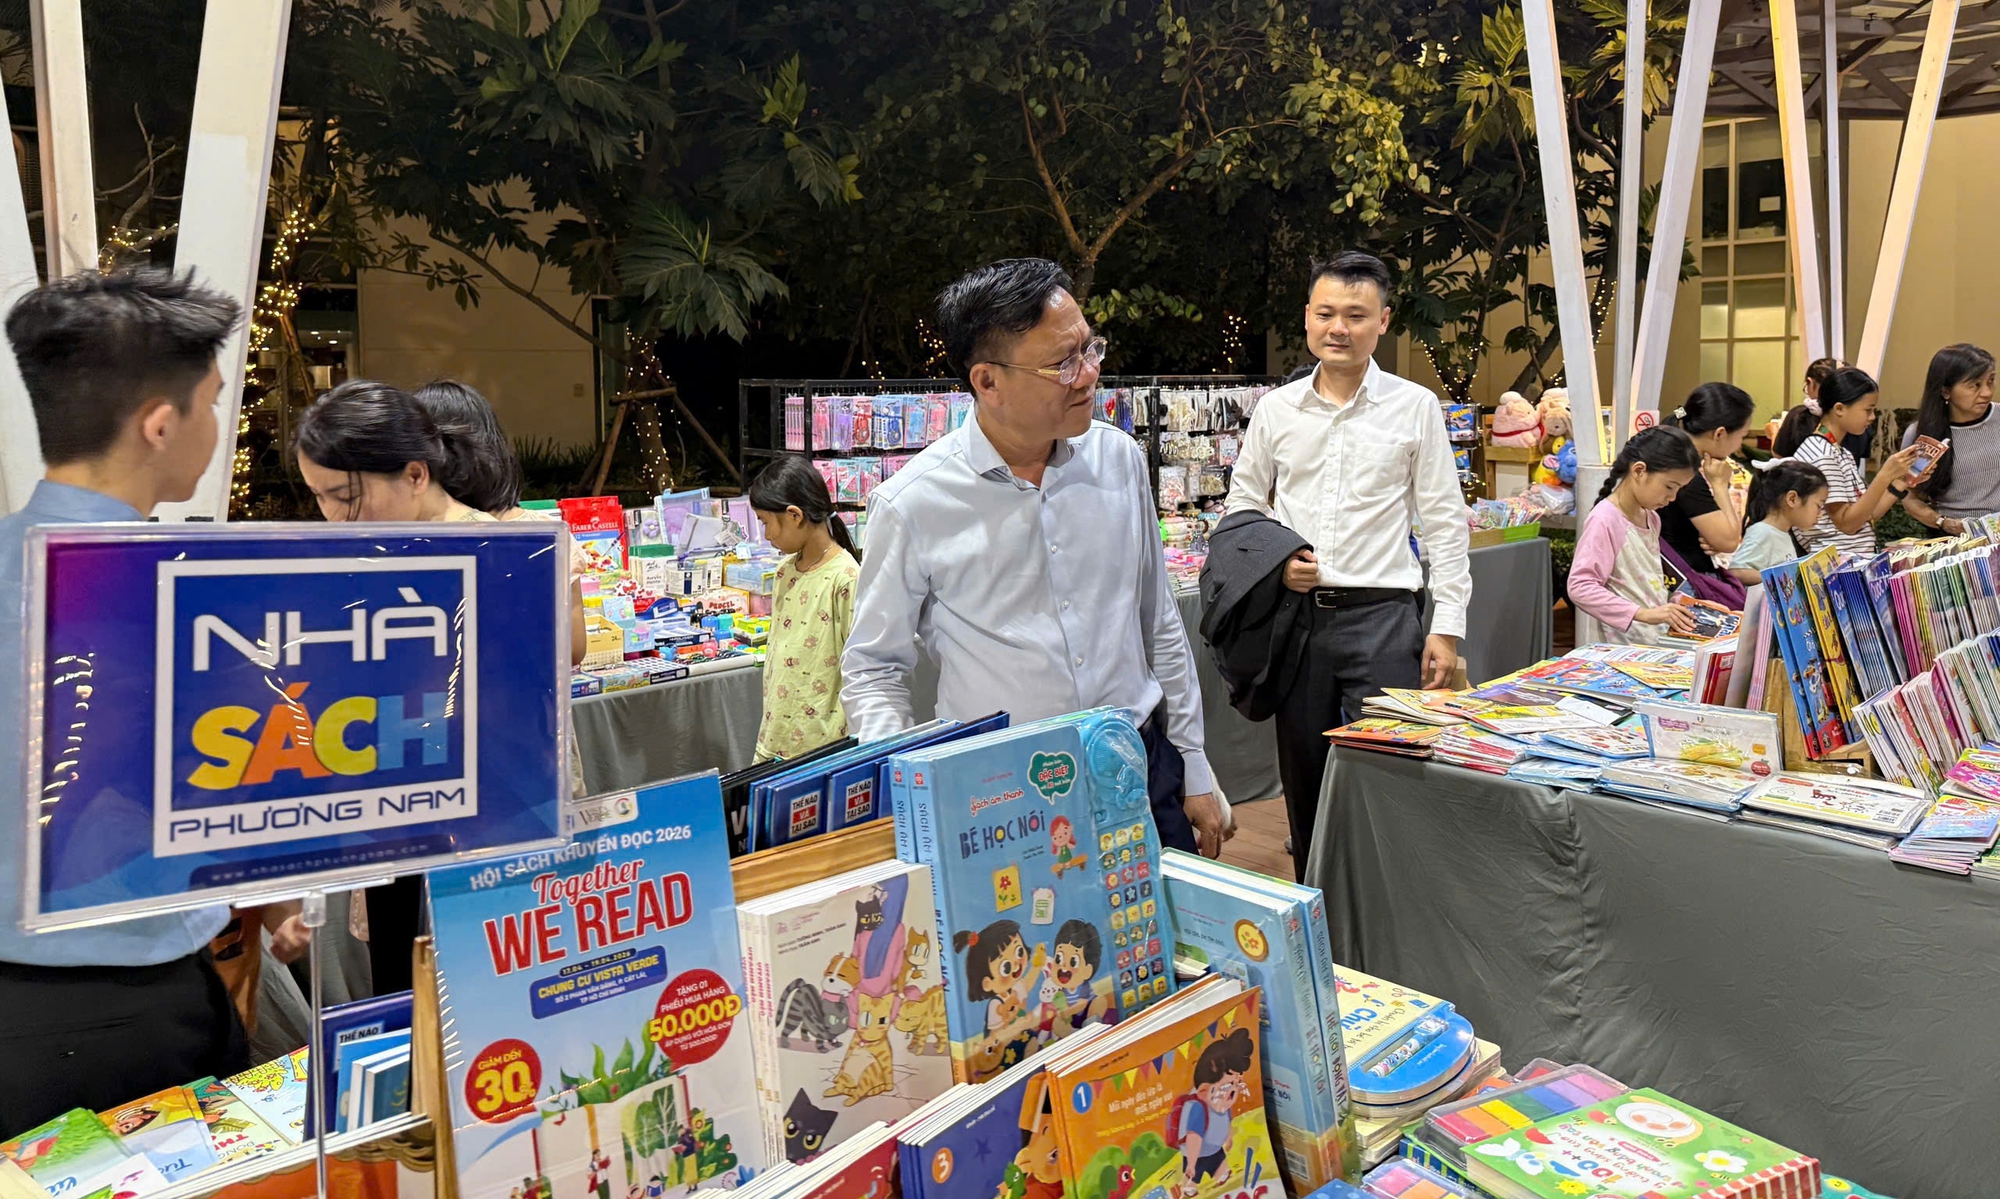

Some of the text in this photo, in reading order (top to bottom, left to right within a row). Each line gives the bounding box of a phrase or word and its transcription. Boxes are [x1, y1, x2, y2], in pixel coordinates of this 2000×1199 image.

[193, 587, 448, 672] NHÀ
[187, 681, 447, 790] SÁCH
[170, 787, 465, 842] PHƯƠNG NAM
[803, 818, 817, 831] SAO
[857, 803, 870, 815] SAO
[469, 825, 692, 891] HỘI SÁCH KHUYẾN ĐỌC 2026
[960, 827, 979, 859] BÉ
[983, 820, 1015, 850] HỌC
[532, 859, 644, 905] Together
[485, 905, 566, 976] WE
[575, 872, 693, 953] READ
[538, 980, 575, 999] CHUNG
[626, 954, 660, 973] VERDE
[676, 980, 708, 997] TẶNG 01
[649, 994, 742, 1041] 50.000Đ
[661, 986, 725, 1012] PHIẾU MUA HÀNG
[357, 1026, 379, 1038] NÀO
[503, 1048, 522, 1062] ĐẾN
[475, 1061, 536, 1112] 30%
[1077, 1086, 1088, 1109] 1
[938, 1152, 950, 1179] 3
